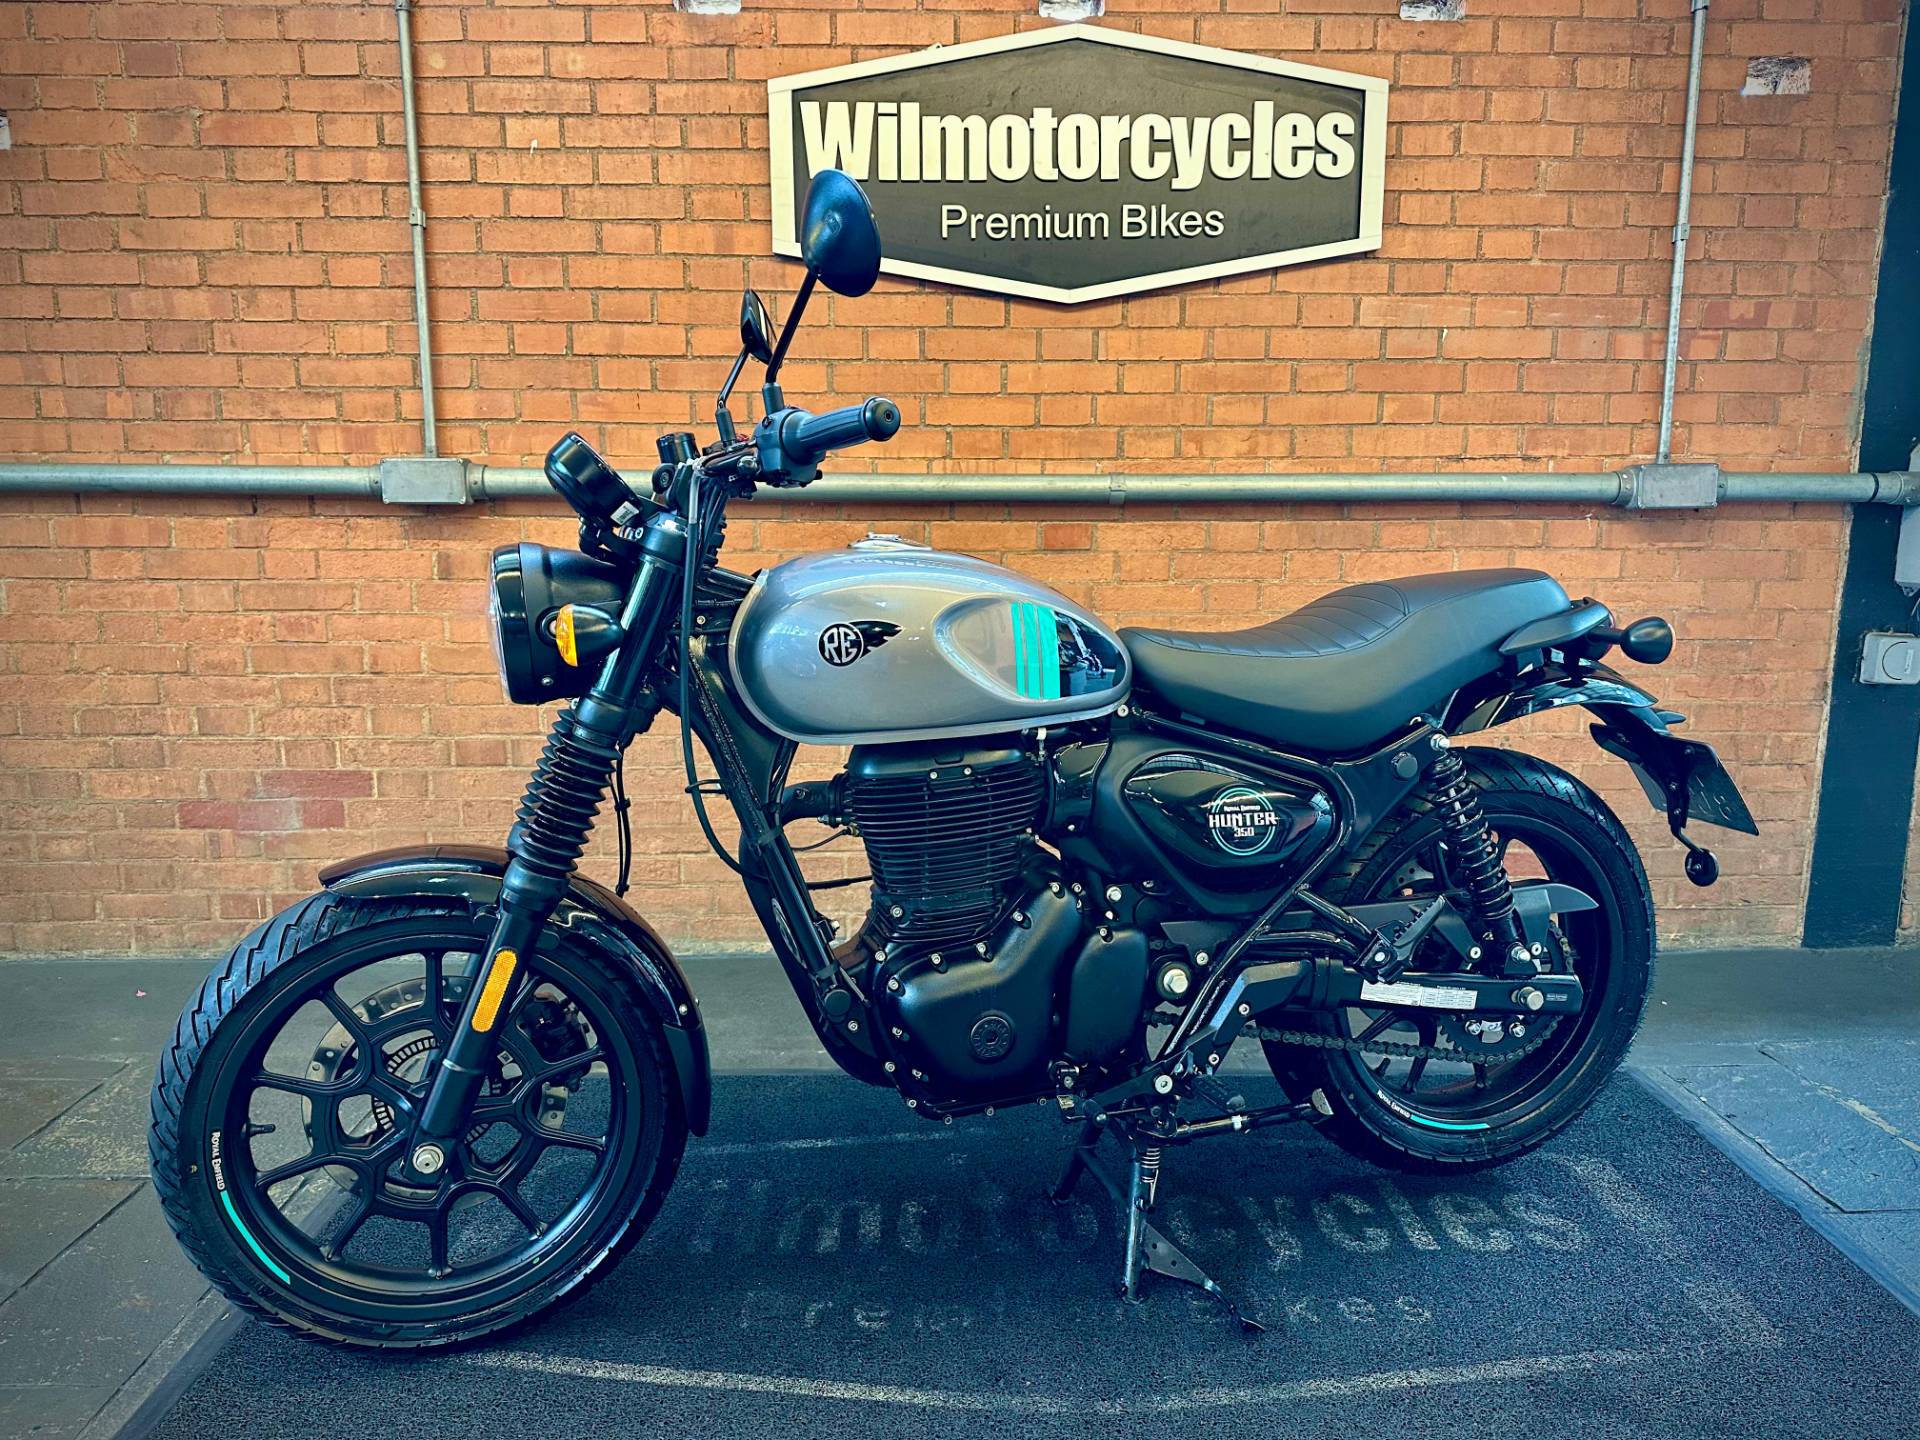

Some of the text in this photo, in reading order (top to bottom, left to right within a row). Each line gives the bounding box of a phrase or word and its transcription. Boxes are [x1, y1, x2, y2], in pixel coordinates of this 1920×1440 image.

[799, 100, 1356, 190] Wilmotorcycles
[940, 204, 1110, 240] Premium
[1208, 811, 1278, 828] HUNTER
